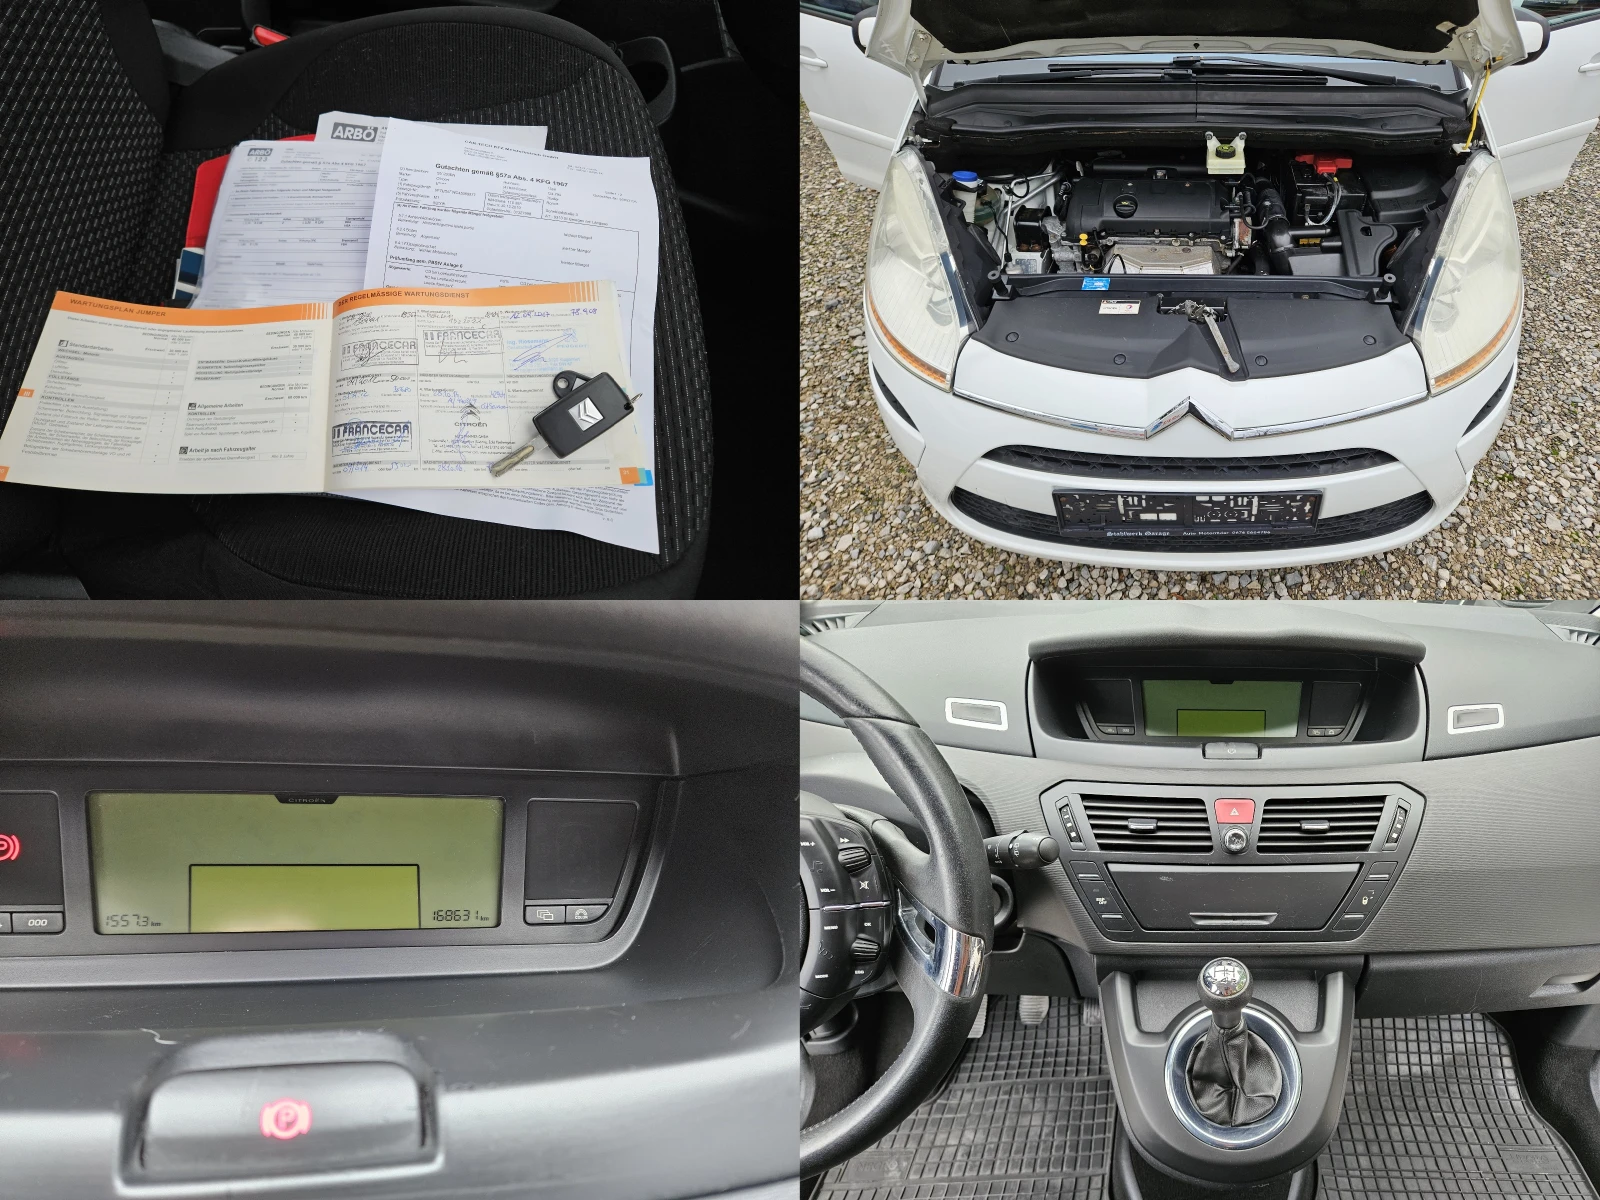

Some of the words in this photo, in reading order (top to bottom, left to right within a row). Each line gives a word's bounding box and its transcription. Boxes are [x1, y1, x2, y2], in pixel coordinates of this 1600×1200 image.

[332, 125, 376, 142] ARBÖ
[249, 148, 271, 156] ARBÖ
[436, 163, 470, 173] Gutachten
[471, 169, 494, 177] gemäß
[513, 174, 528, 182] Abs.
[349, 290, 402, 303] REGELMÄSSIGE
[404, 290, 470, 299] WARTUNGSDIENST
[70, 299, 134, 314] WARTUNGSPLAN
[136, 309, 166, 317] JUMPER
[437, 330, 501, 341] FRANCECAR
[342, 424, 409, 437] FRANCECAR
[106, 914, 149, 927] 1557.3
